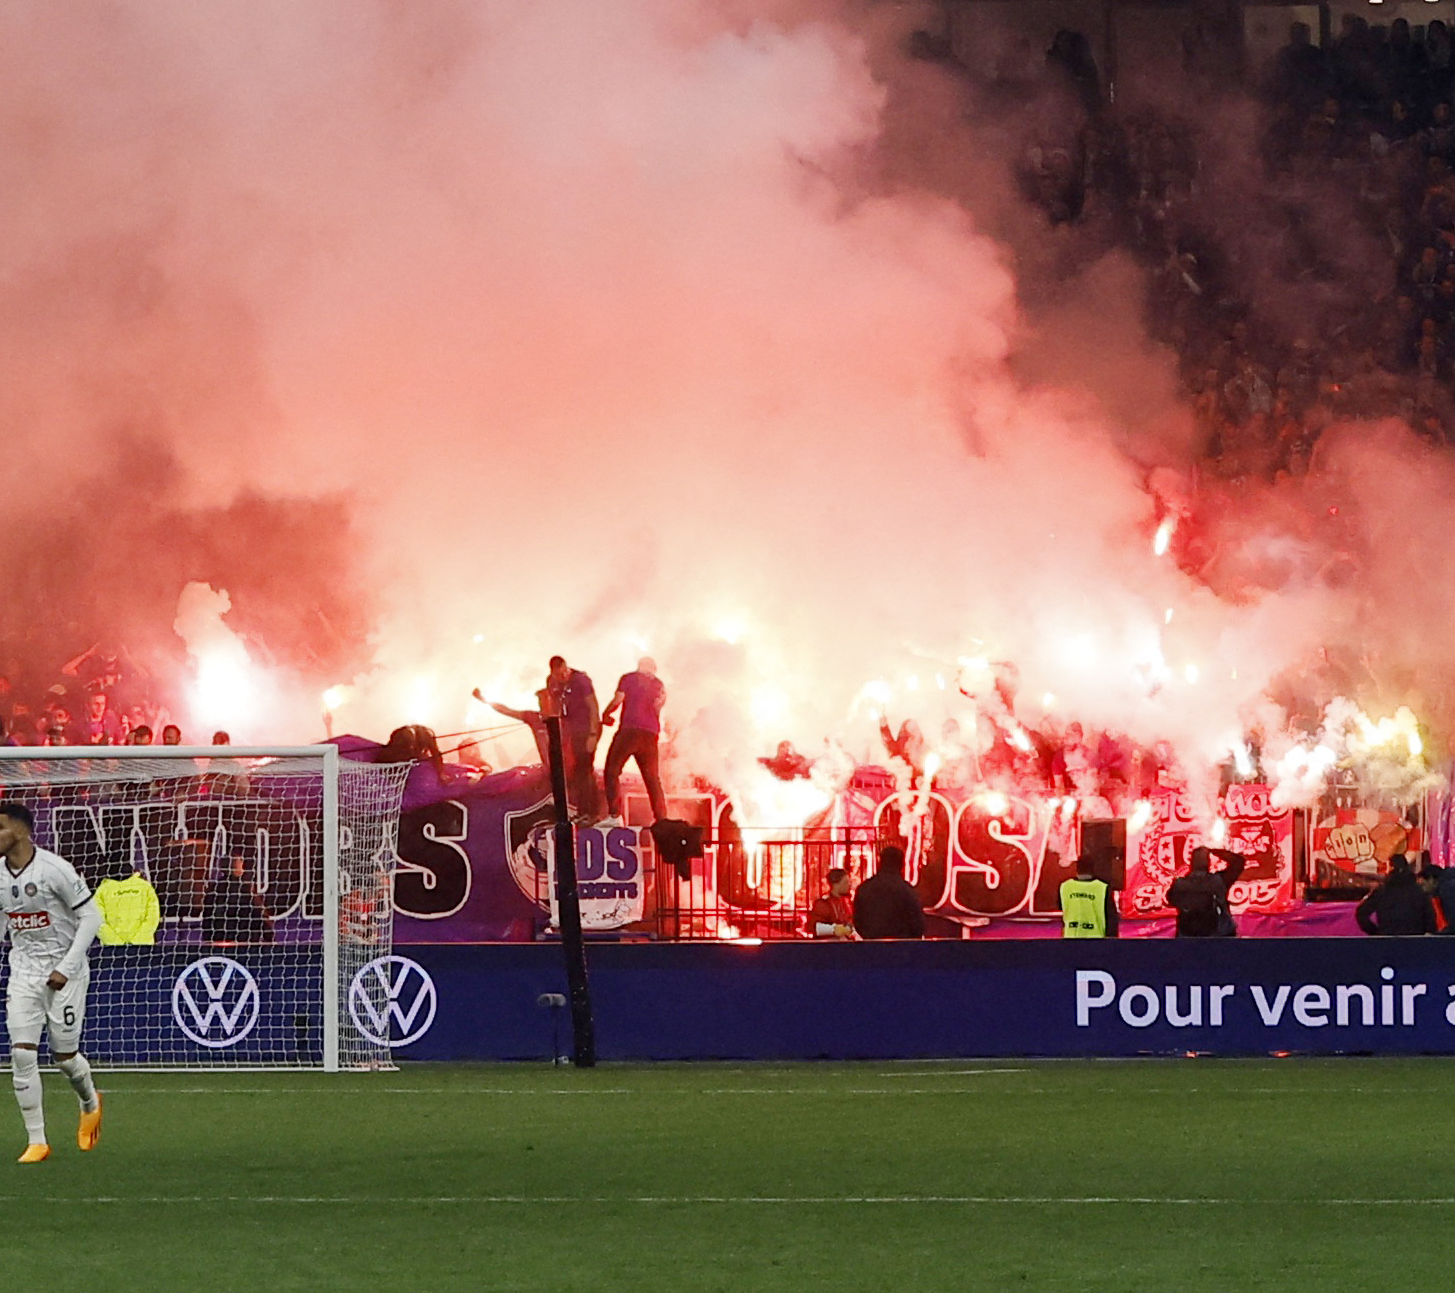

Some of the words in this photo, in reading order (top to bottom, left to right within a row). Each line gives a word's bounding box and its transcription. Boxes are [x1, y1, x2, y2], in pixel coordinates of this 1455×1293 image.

[63, 1005, 76, 1027] 6
[1077, 971, 1234, 1027] Pour
[1250, 967, 1426, 1027] venir
